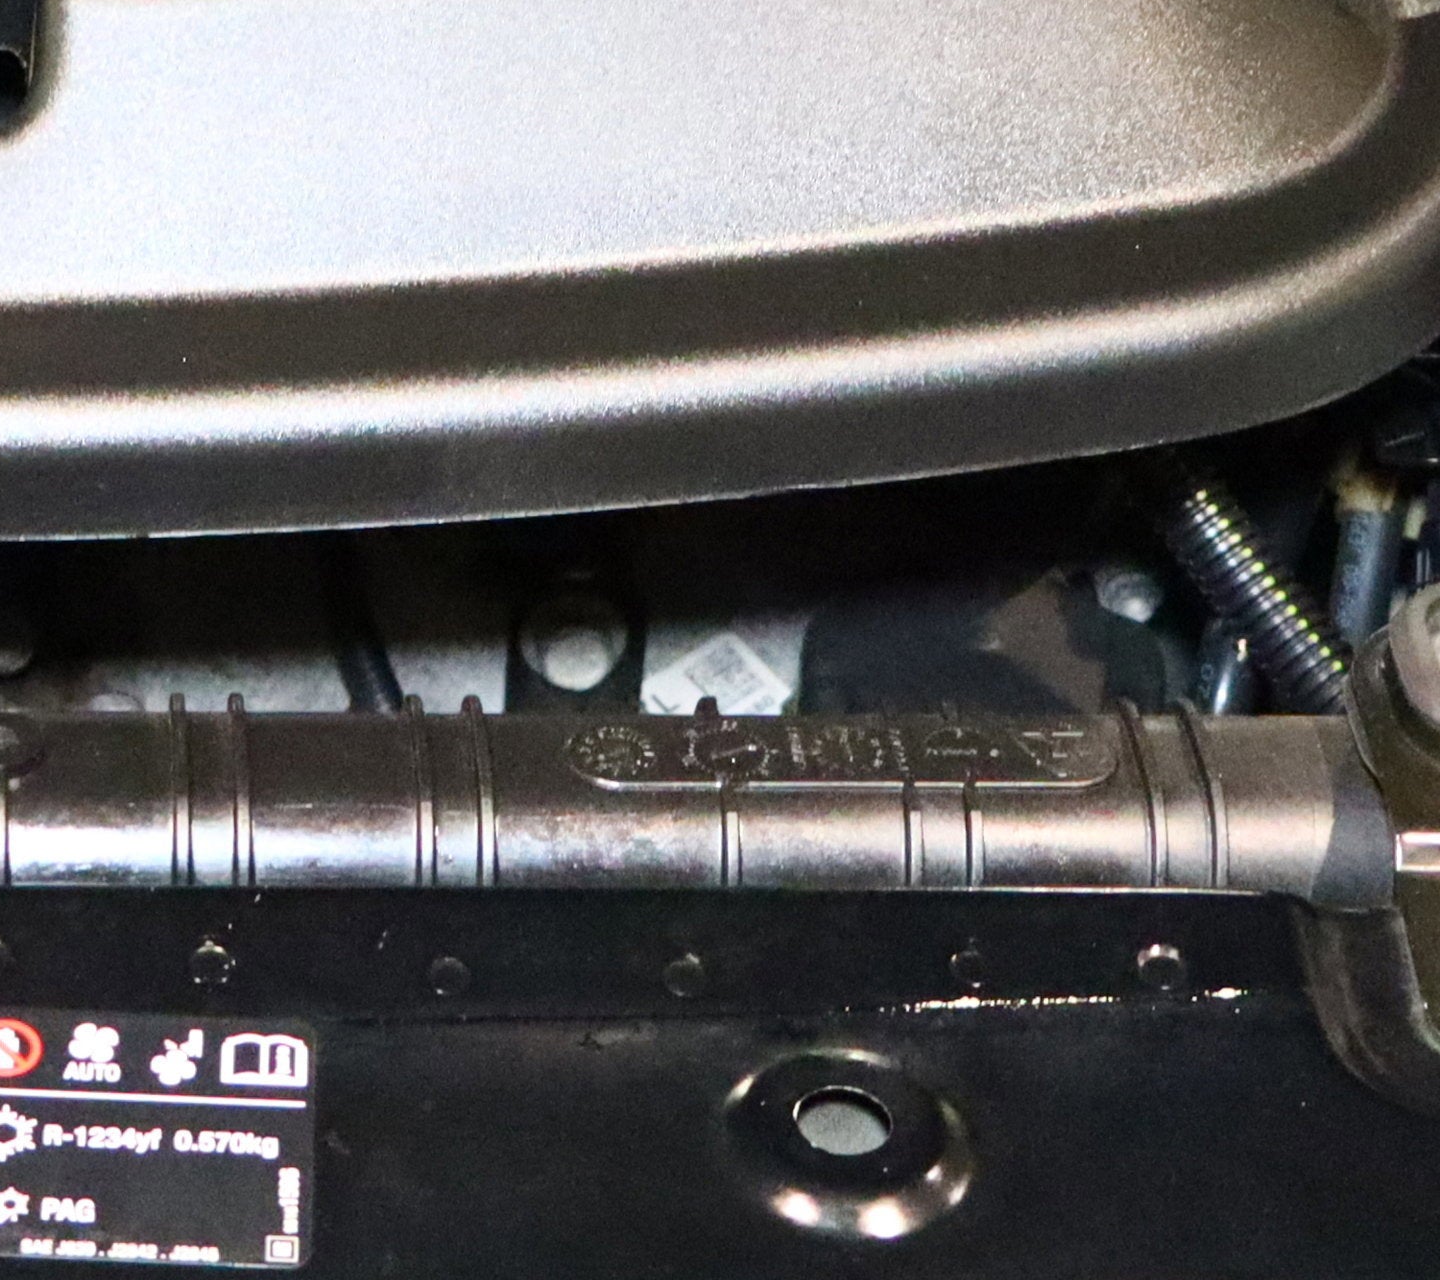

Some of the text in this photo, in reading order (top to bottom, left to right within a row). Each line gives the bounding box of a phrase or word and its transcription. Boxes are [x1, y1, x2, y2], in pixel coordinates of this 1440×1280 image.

[63, 1062, 121, 1083] AUTO
[42, 1123, 280, 1160] R-1234yf 0.570kg
[40, 1195, 96, 1224] PAG
